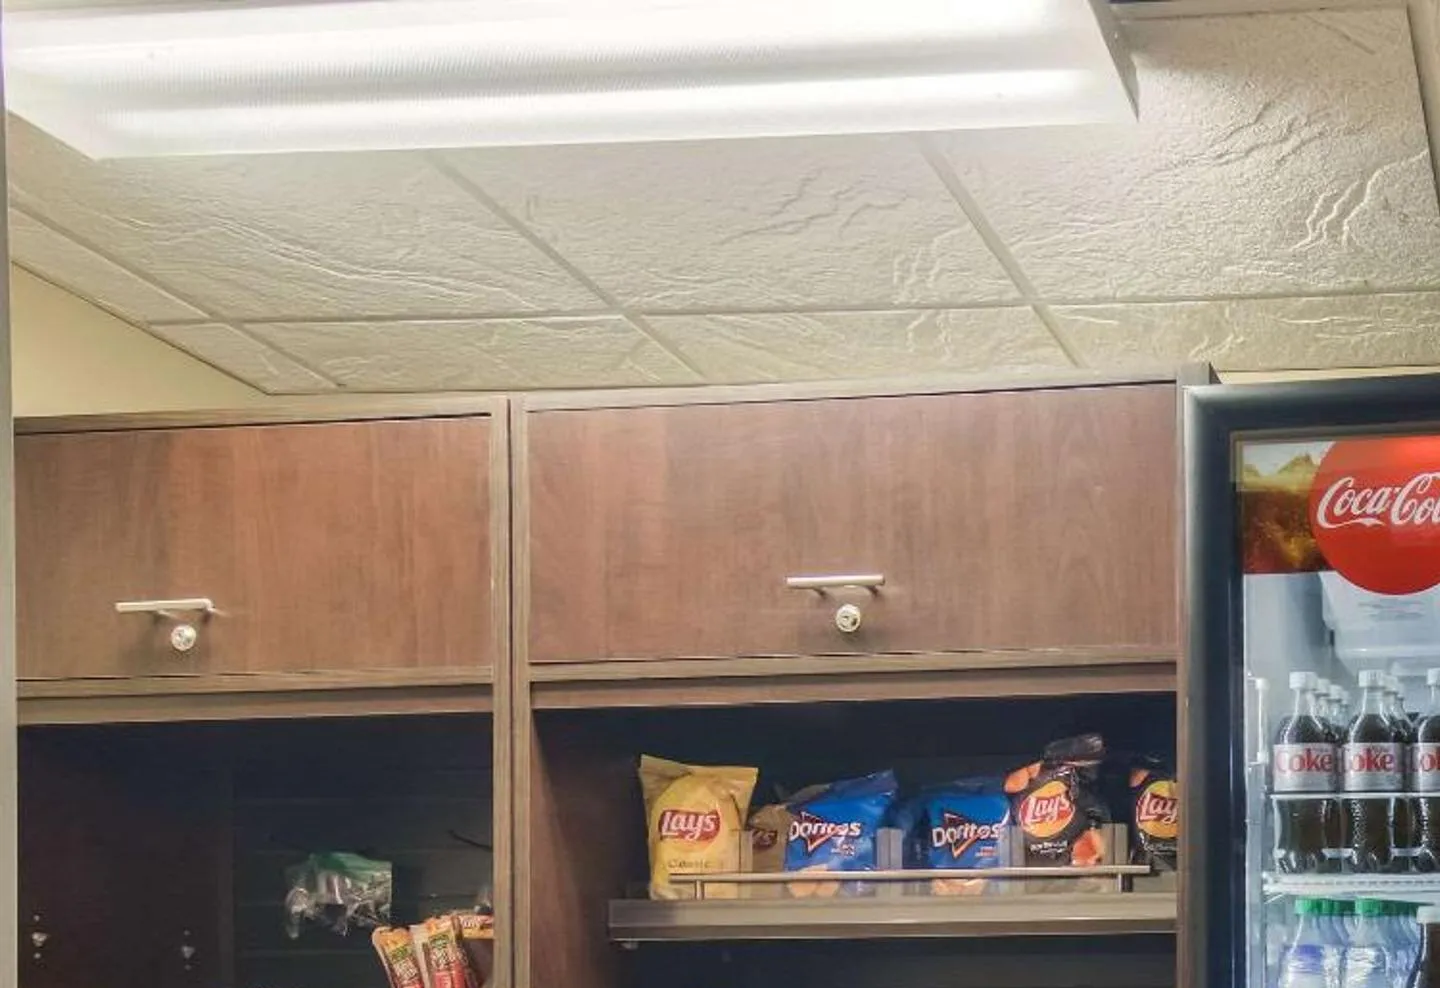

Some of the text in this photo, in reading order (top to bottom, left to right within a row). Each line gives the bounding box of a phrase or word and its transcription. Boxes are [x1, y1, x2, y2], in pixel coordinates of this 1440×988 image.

[1276, 748, 1333, 773] Coke
[1352, 746, 1394, 772] oke
[1026, 795, 1072, 825] Lay's
[1140, 795, 1178, 823] Lay
[661, 810, 719, 841] Lay's
[789, 820, 861, 841] Doritos
[932, 822, 1002, 848] Doritos
